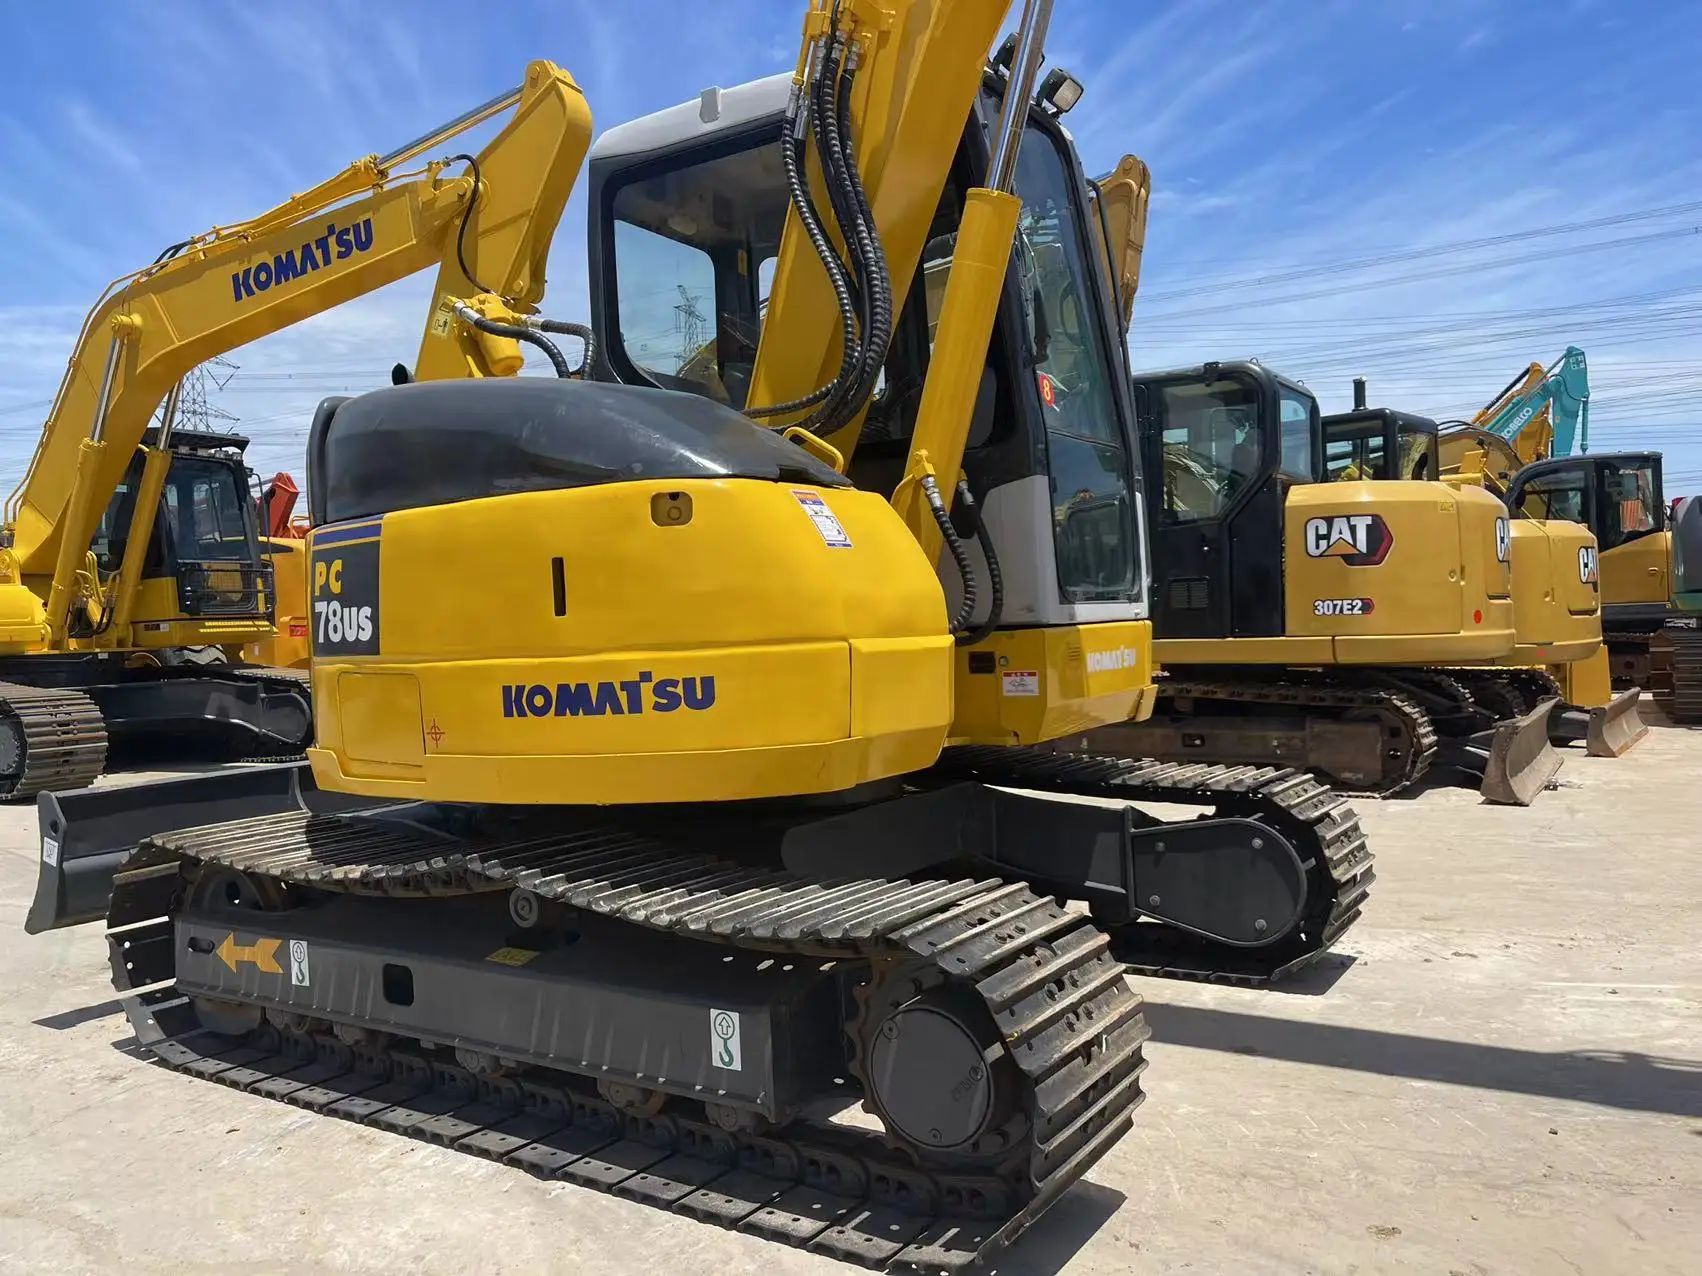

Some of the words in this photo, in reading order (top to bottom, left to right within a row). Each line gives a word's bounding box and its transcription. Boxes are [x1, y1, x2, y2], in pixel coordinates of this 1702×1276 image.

[231, 218, 374, 302] KOMATSU
[1043, 379, 1051, 401] 8
[1306, 515, 1373, 557] CAT
[314, 559, 343, 596] PC
[314, 600, 373, 643] 78US
[1314, 599, 1363, 616] 307E2
[501, 671, 716, 718] KOMATSU
